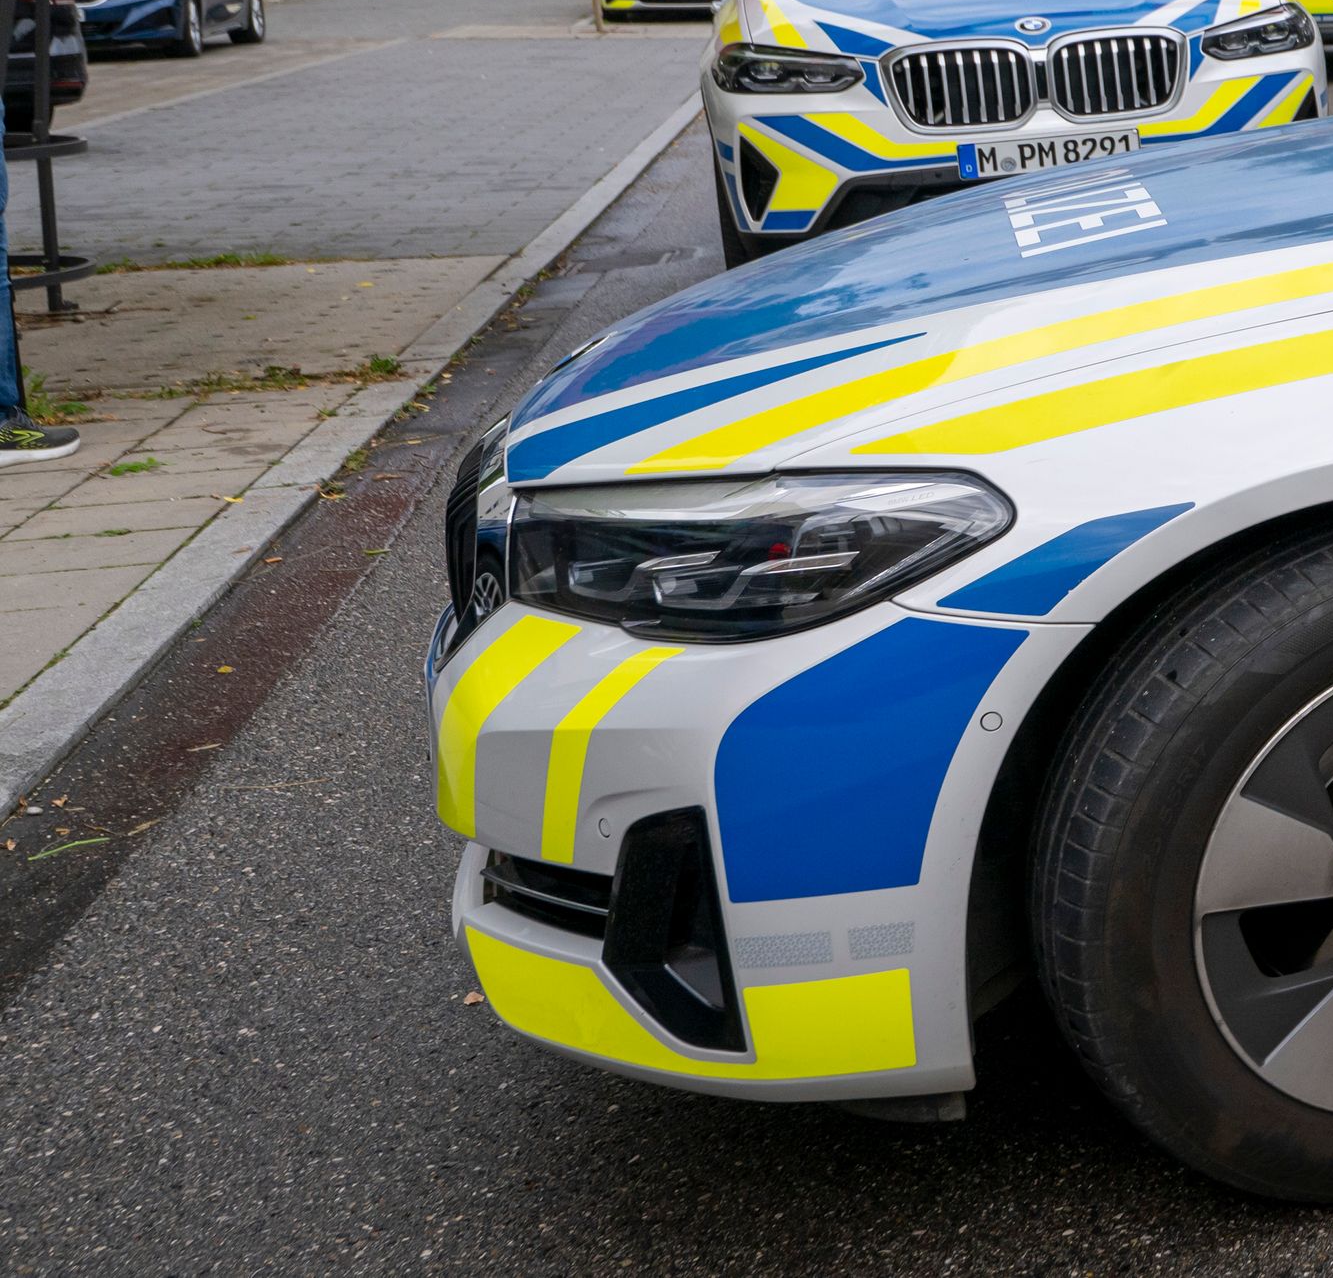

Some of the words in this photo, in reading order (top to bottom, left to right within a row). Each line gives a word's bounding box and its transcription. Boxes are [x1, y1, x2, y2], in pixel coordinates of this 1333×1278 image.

[977, 146, 998, 172] M
[1018, 141, 1057, 169] PM
[1063, 134, 1131, 164] 8291
[1002, 169, 1168, 258] LIZEI
